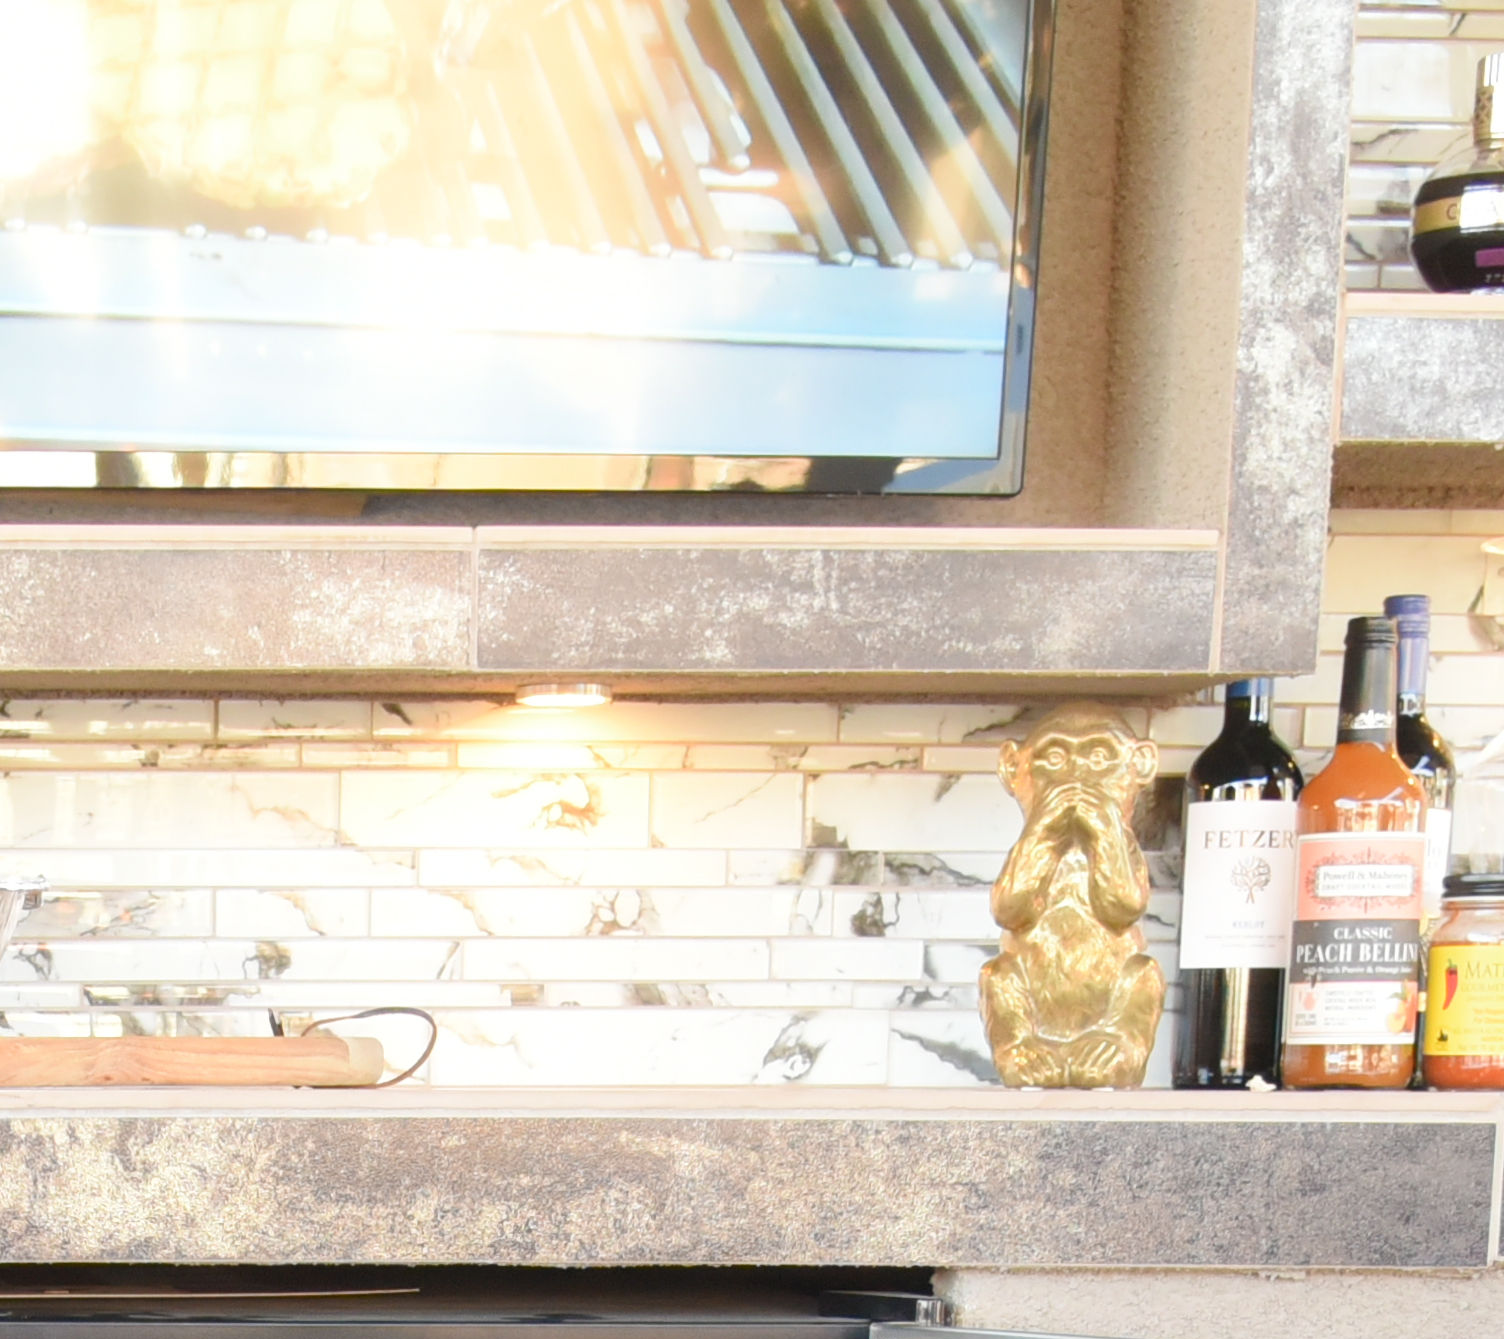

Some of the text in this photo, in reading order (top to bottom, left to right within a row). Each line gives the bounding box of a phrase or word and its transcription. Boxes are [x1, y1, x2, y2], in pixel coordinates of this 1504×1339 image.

[1204, 829, 1294, 850] FETZER
[1333, 926, 1393, 941] CLASSIC
[1296, 942, 1353, 964] PEACH
